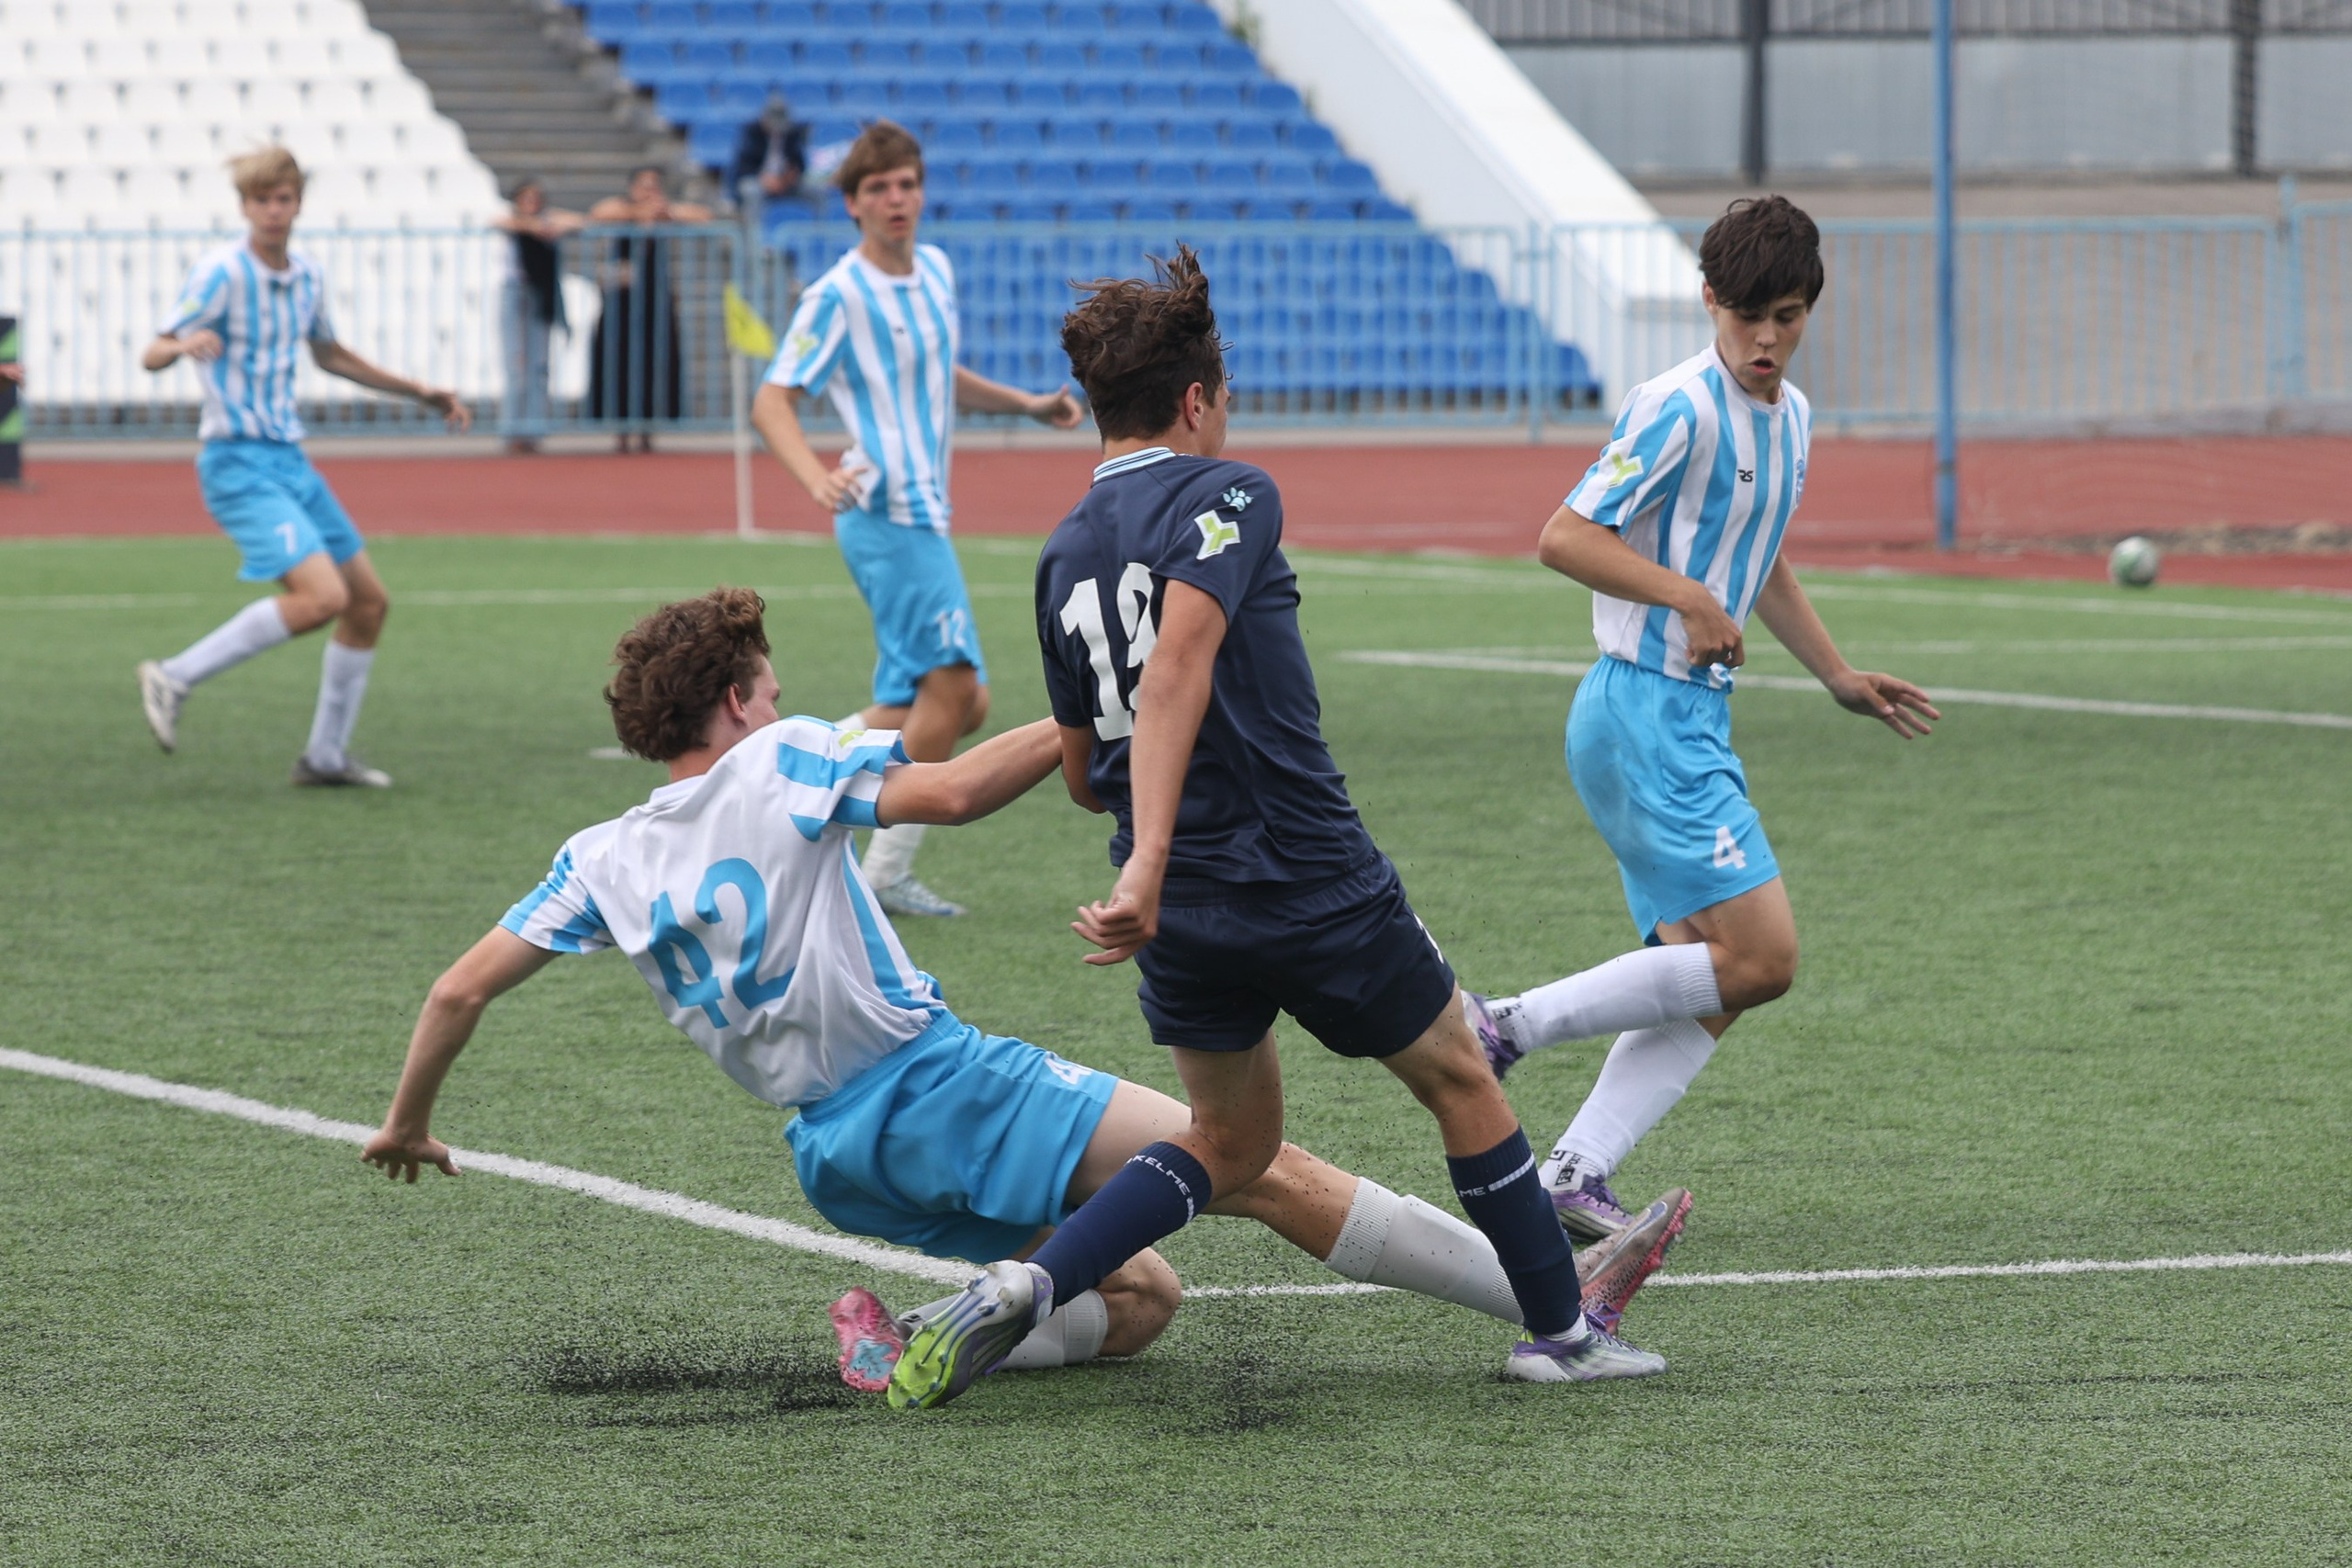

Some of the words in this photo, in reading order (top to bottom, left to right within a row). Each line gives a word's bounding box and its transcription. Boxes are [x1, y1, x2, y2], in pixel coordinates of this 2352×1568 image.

[933, 608, 967, 649] 12
[1713, 825, 1747, 870] 4
[648, 857, 797, 1029] 42
[1132, 1155, 1192, 1196] KELME
